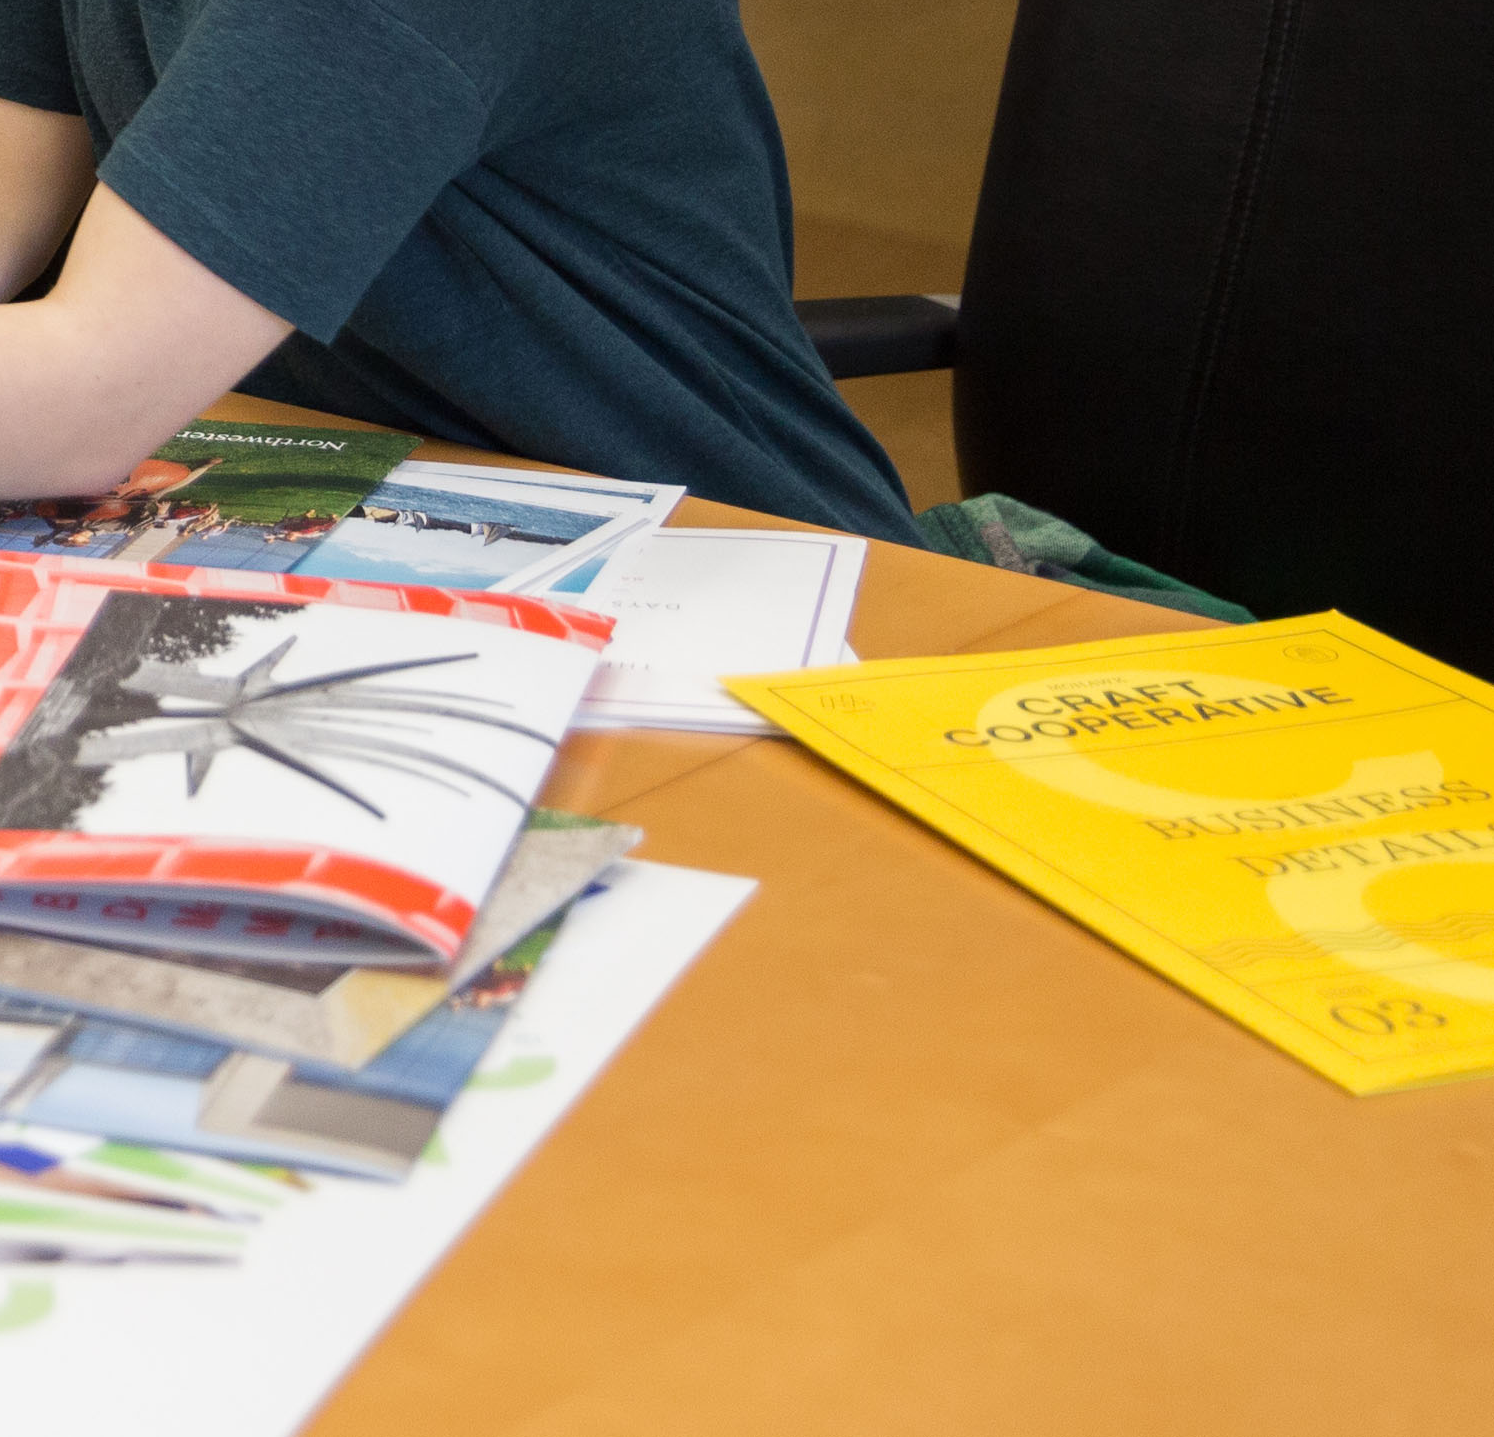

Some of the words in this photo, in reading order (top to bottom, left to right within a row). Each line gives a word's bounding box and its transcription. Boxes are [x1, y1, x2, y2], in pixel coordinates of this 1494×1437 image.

[173, 428, 349, 452] Northwester
[943, 685, 1354, 748] COOPERATIVE
[1015, 679, 1206, 718] CRAFT
[1140, 779, 1492, 841] BUSINESS
[1226, 822, 1494, 878] DETAIL
